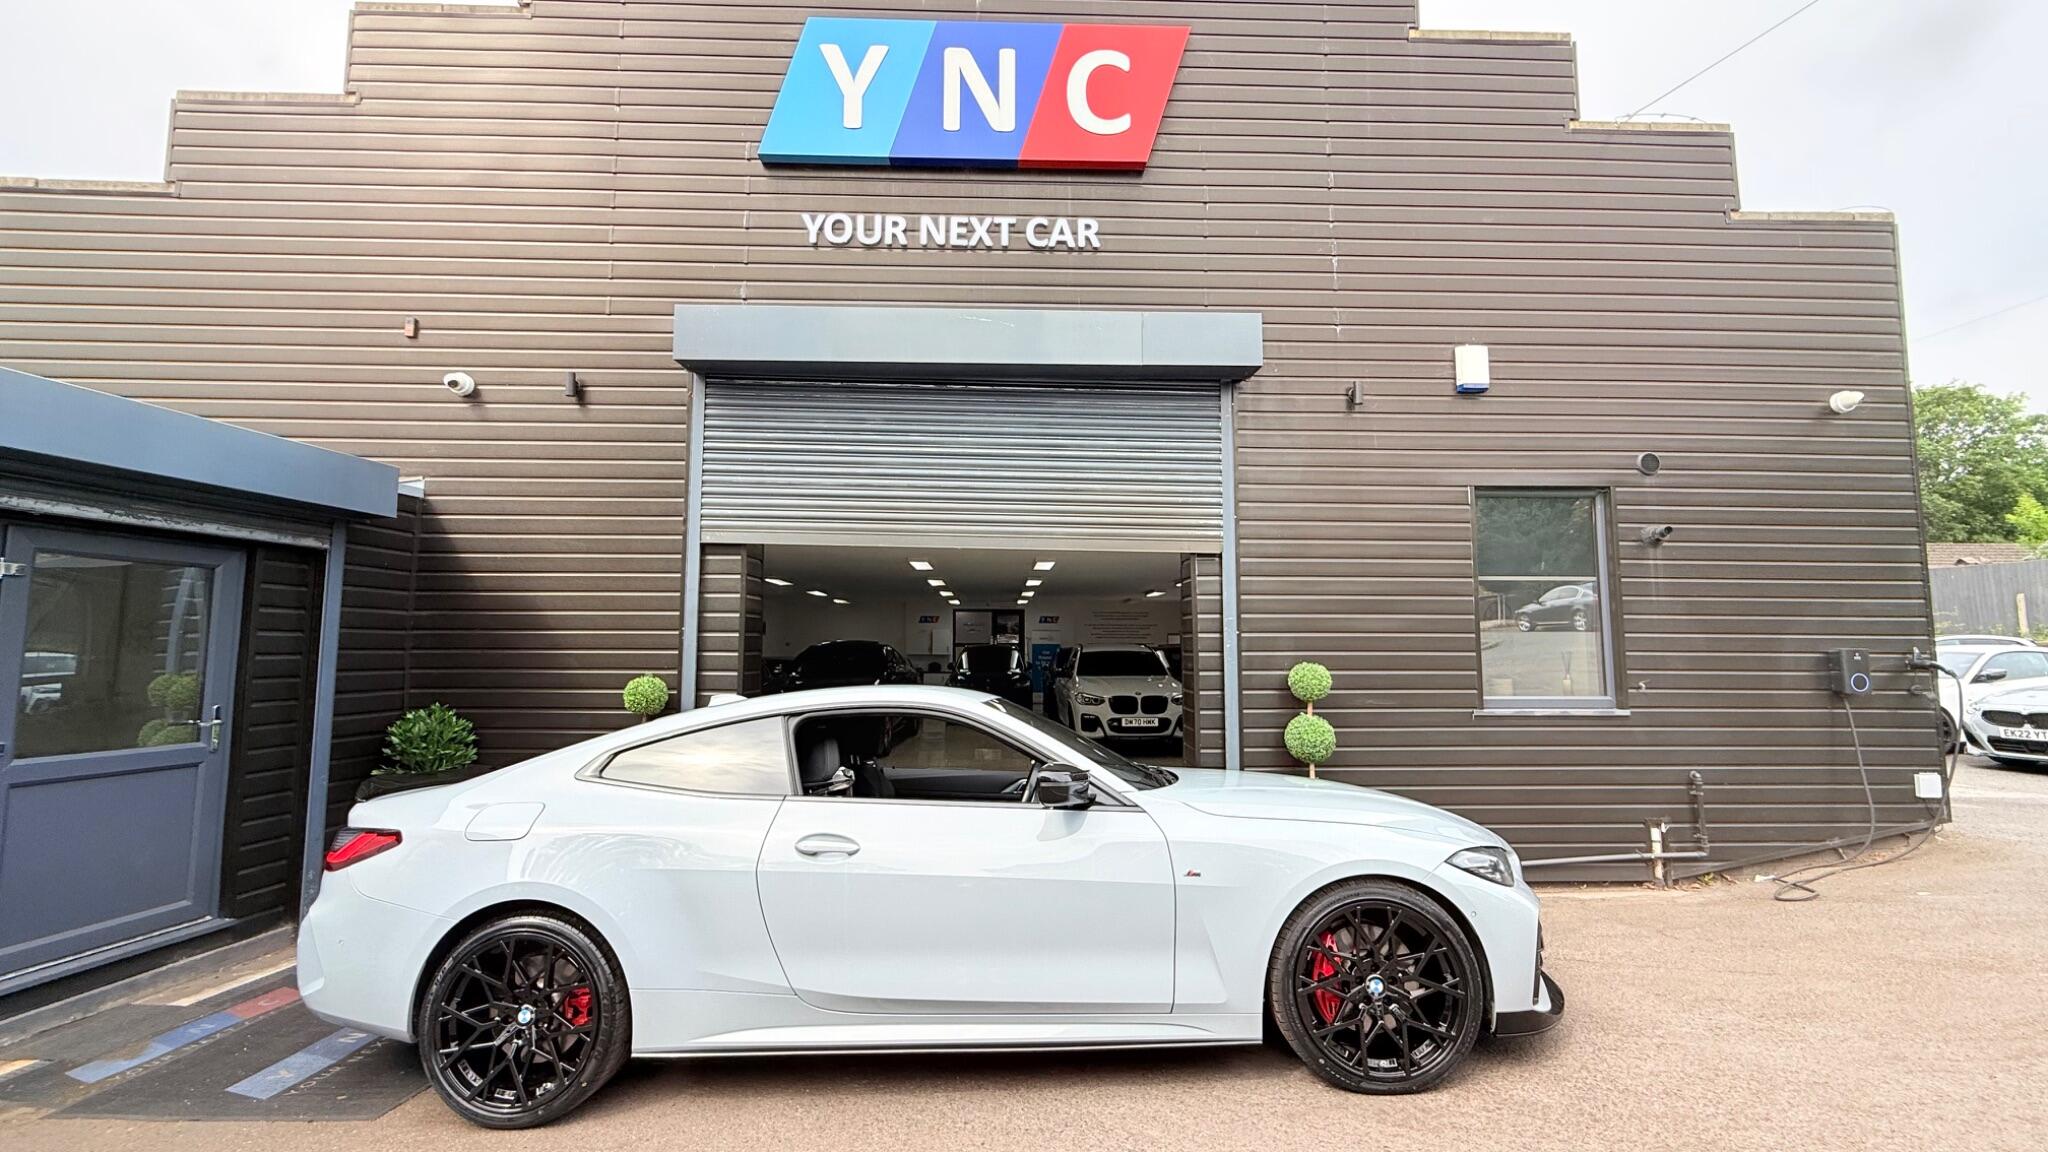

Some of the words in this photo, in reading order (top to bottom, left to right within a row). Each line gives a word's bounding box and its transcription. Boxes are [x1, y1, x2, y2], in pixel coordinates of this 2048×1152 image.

[819, 43, 1131, 135] YNC
[801, 213, 908, 246] YOUR
[919, 216, 1016, 248] NEXT
[1026, 217, 1101, 249] CAR
[2003, 728, 2032, 739] EK22
